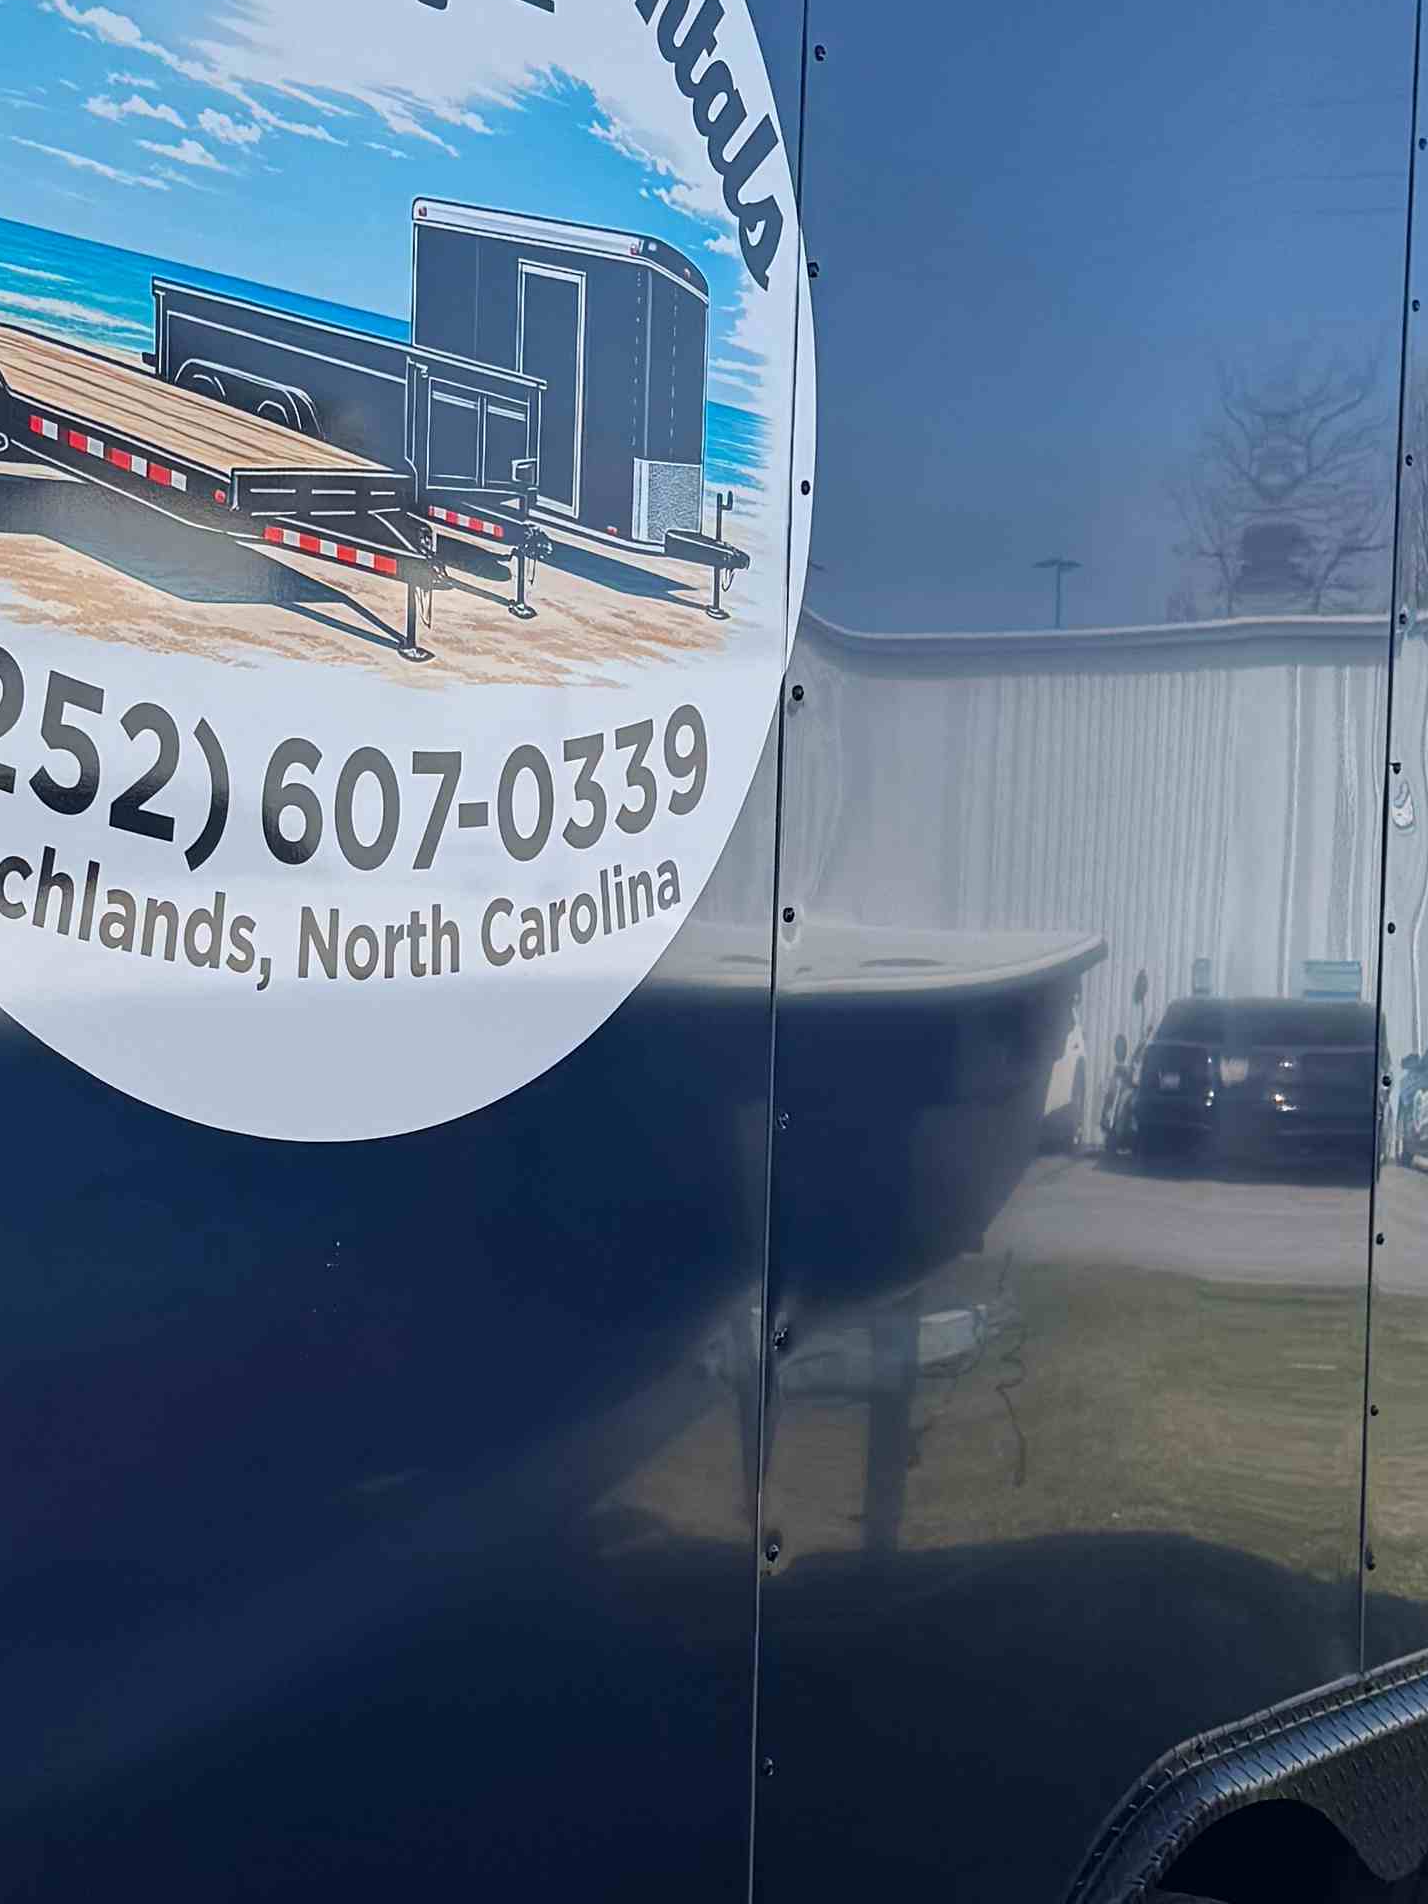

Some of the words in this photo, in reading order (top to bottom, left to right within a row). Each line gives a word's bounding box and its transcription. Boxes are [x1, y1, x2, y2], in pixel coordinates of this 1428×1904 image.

[261, 704, 708, 872] 607-0339
[298, 903, 461, 981] North
[480, 858, 683, 968] Carolina
